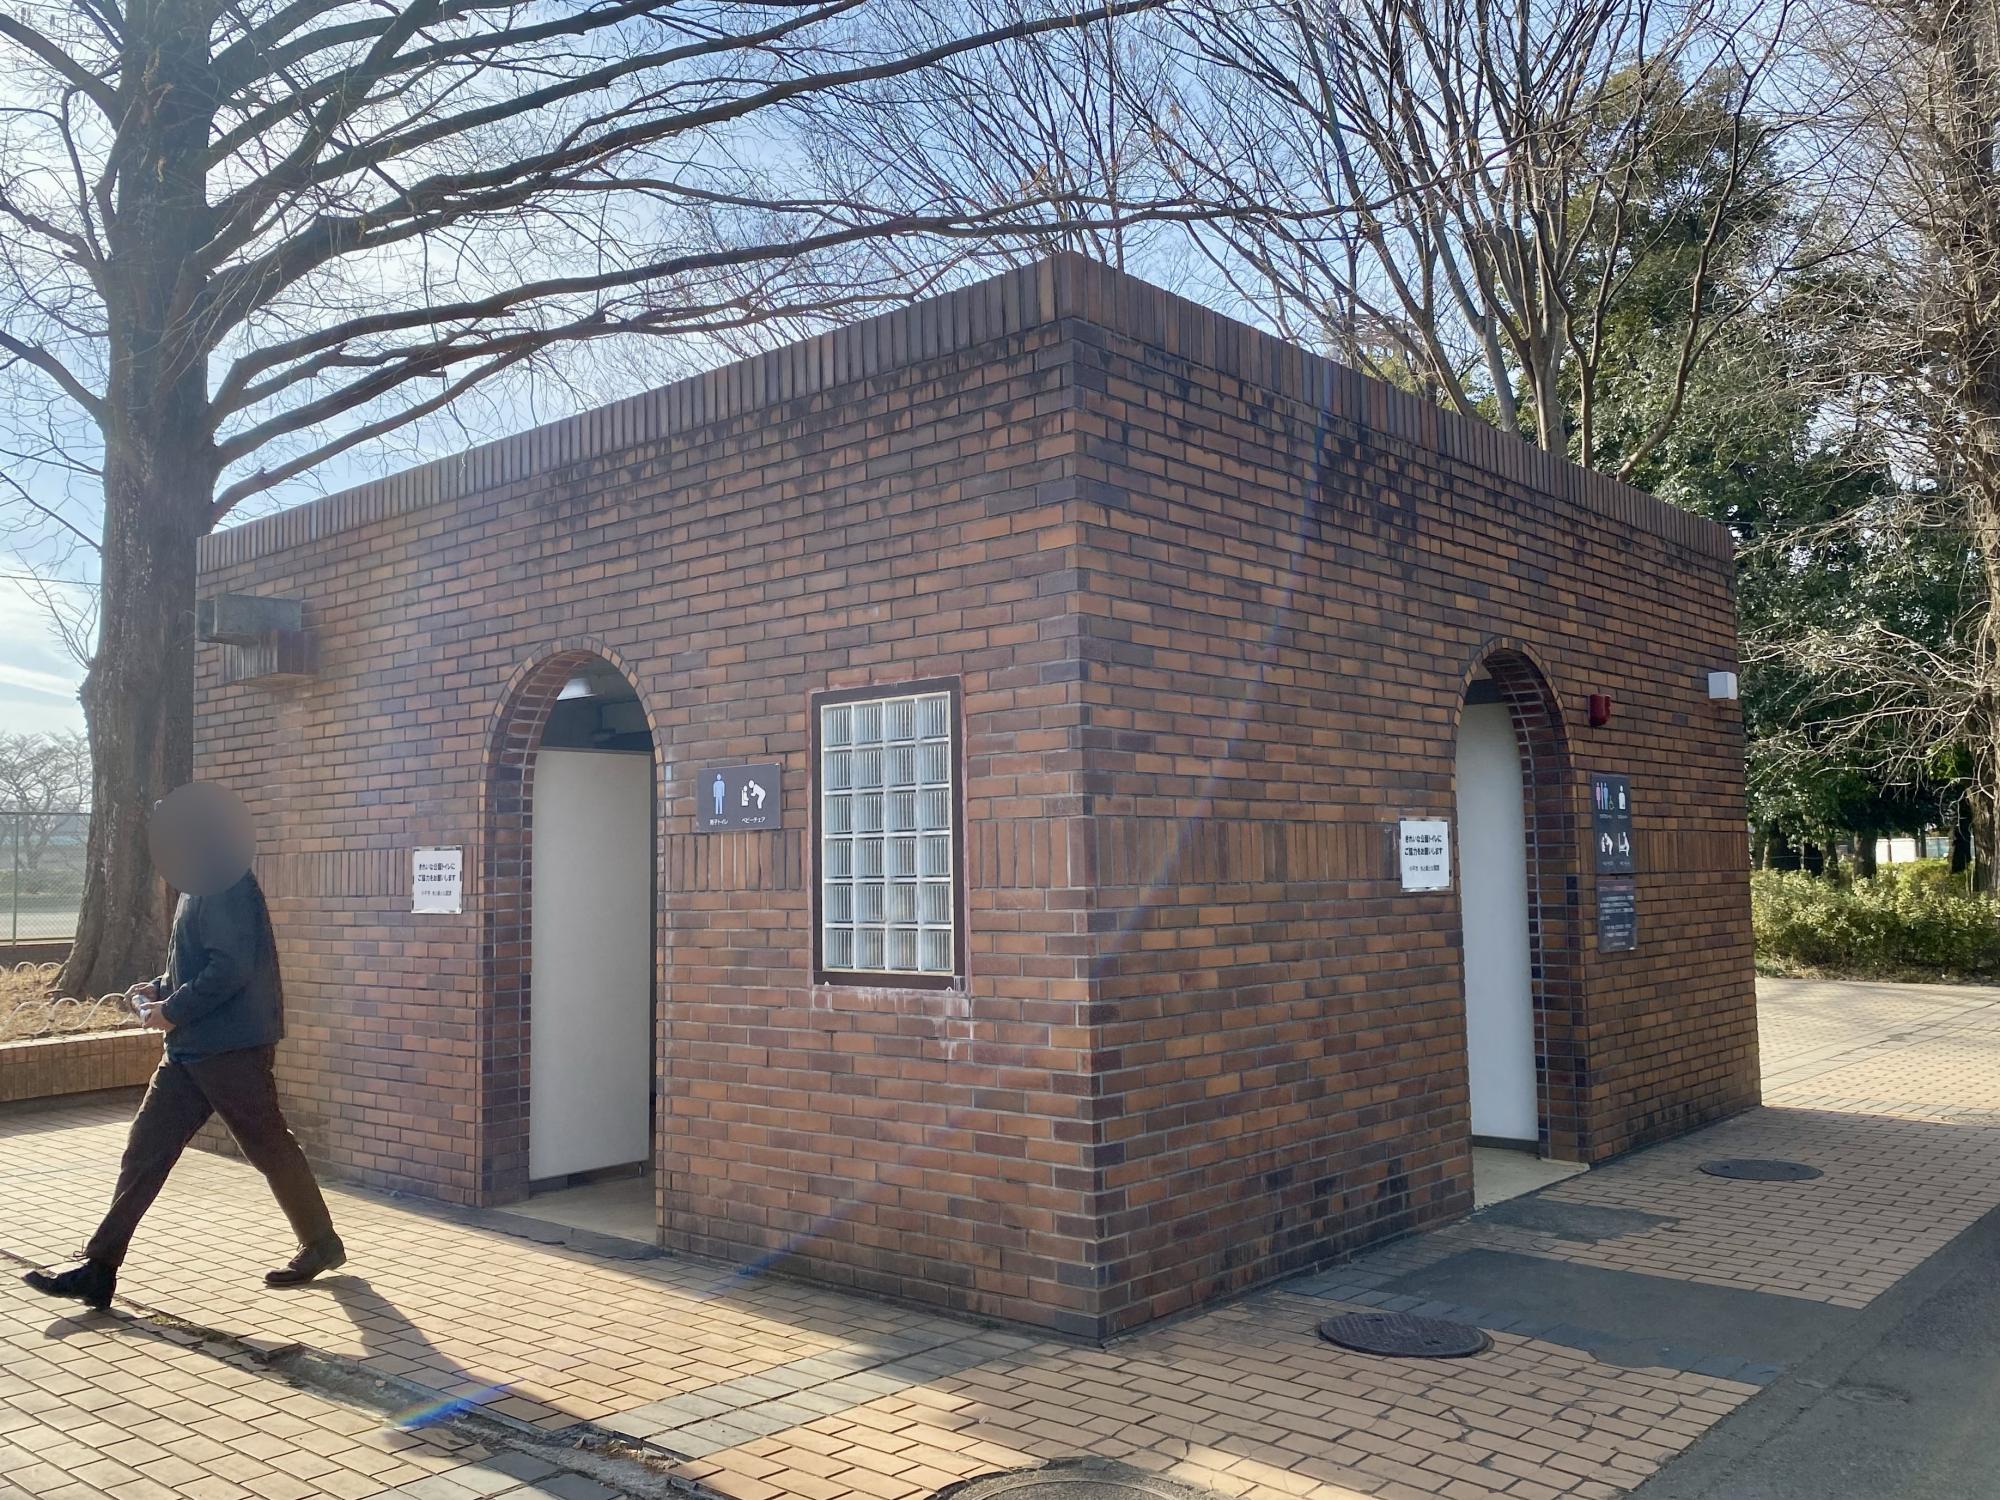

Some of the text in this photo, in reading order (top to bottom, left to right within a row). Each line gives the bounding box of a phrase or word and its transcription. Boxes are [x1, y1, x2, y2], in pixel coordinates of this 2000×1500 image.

[741, 816, 766, 824] ベビーチェア
[1405, 834, 1442, 843] きれいな公園トイレに
[1404, 847, 1443, 856] ご協力をお願いします
[417, 874, 456, 882] ご協力をお願いします
